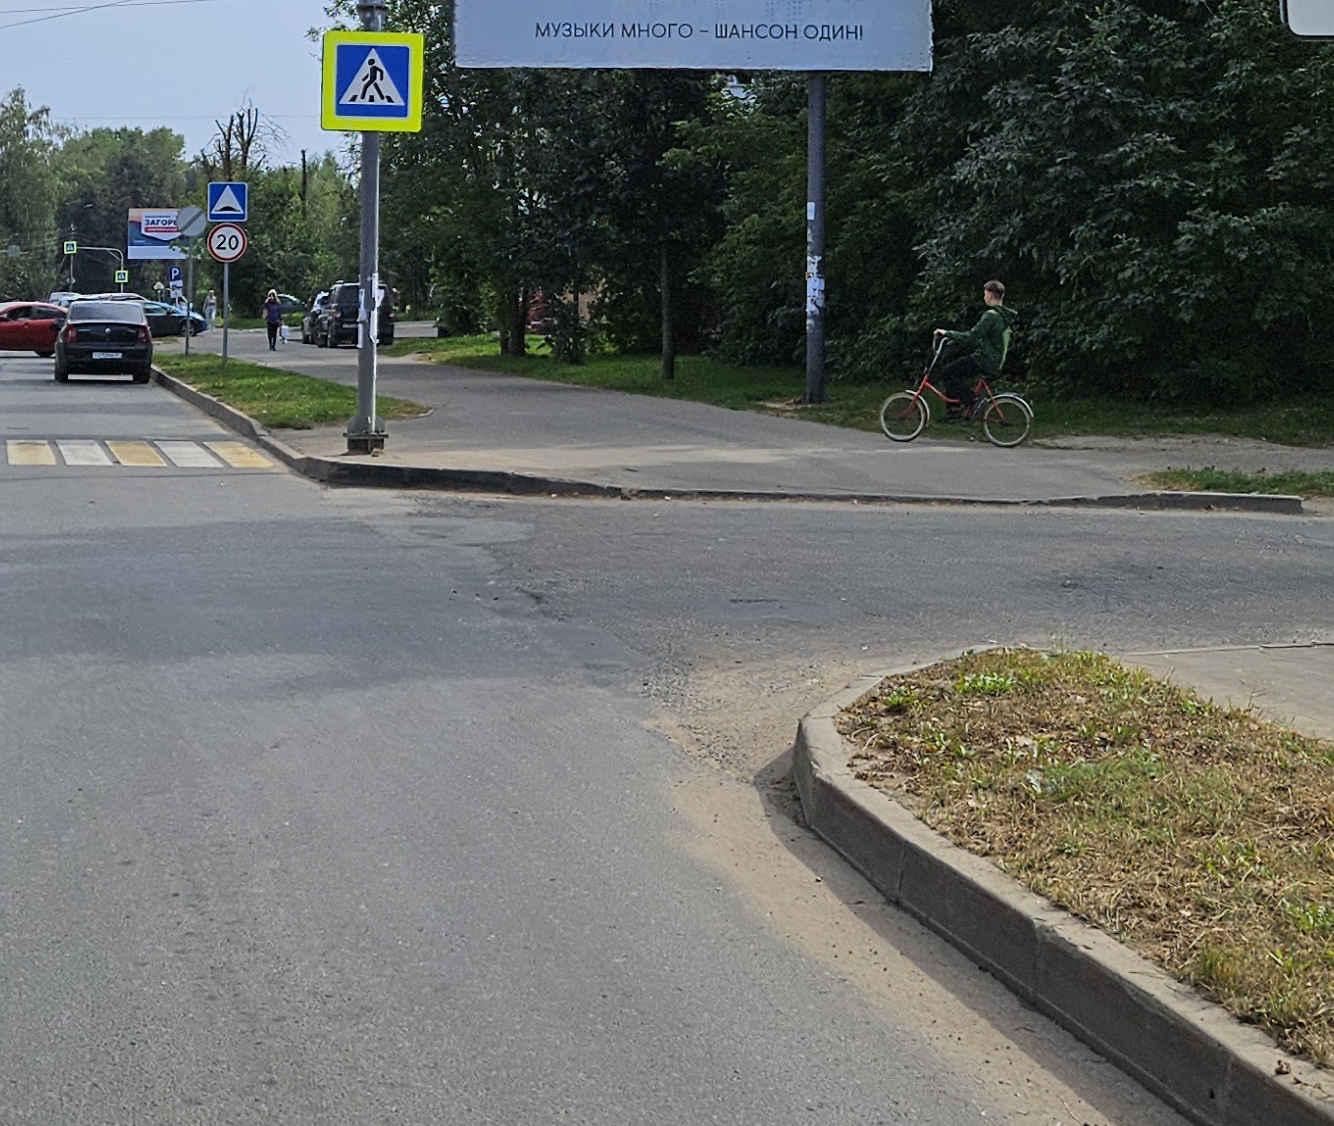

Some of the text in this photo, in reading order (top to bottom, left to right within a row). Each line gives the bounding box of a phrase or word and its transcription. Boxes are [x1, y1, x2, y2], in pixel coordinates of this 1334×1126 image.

[535, 22, 614, 38] МУЗЫКИ
[621, 23, 692, 39] МНОГО
[715, 23, 798, 40] ШАНСОН
[803, 24, 864, 42] ОДИН!
[216, 234, 239, 250] 20
